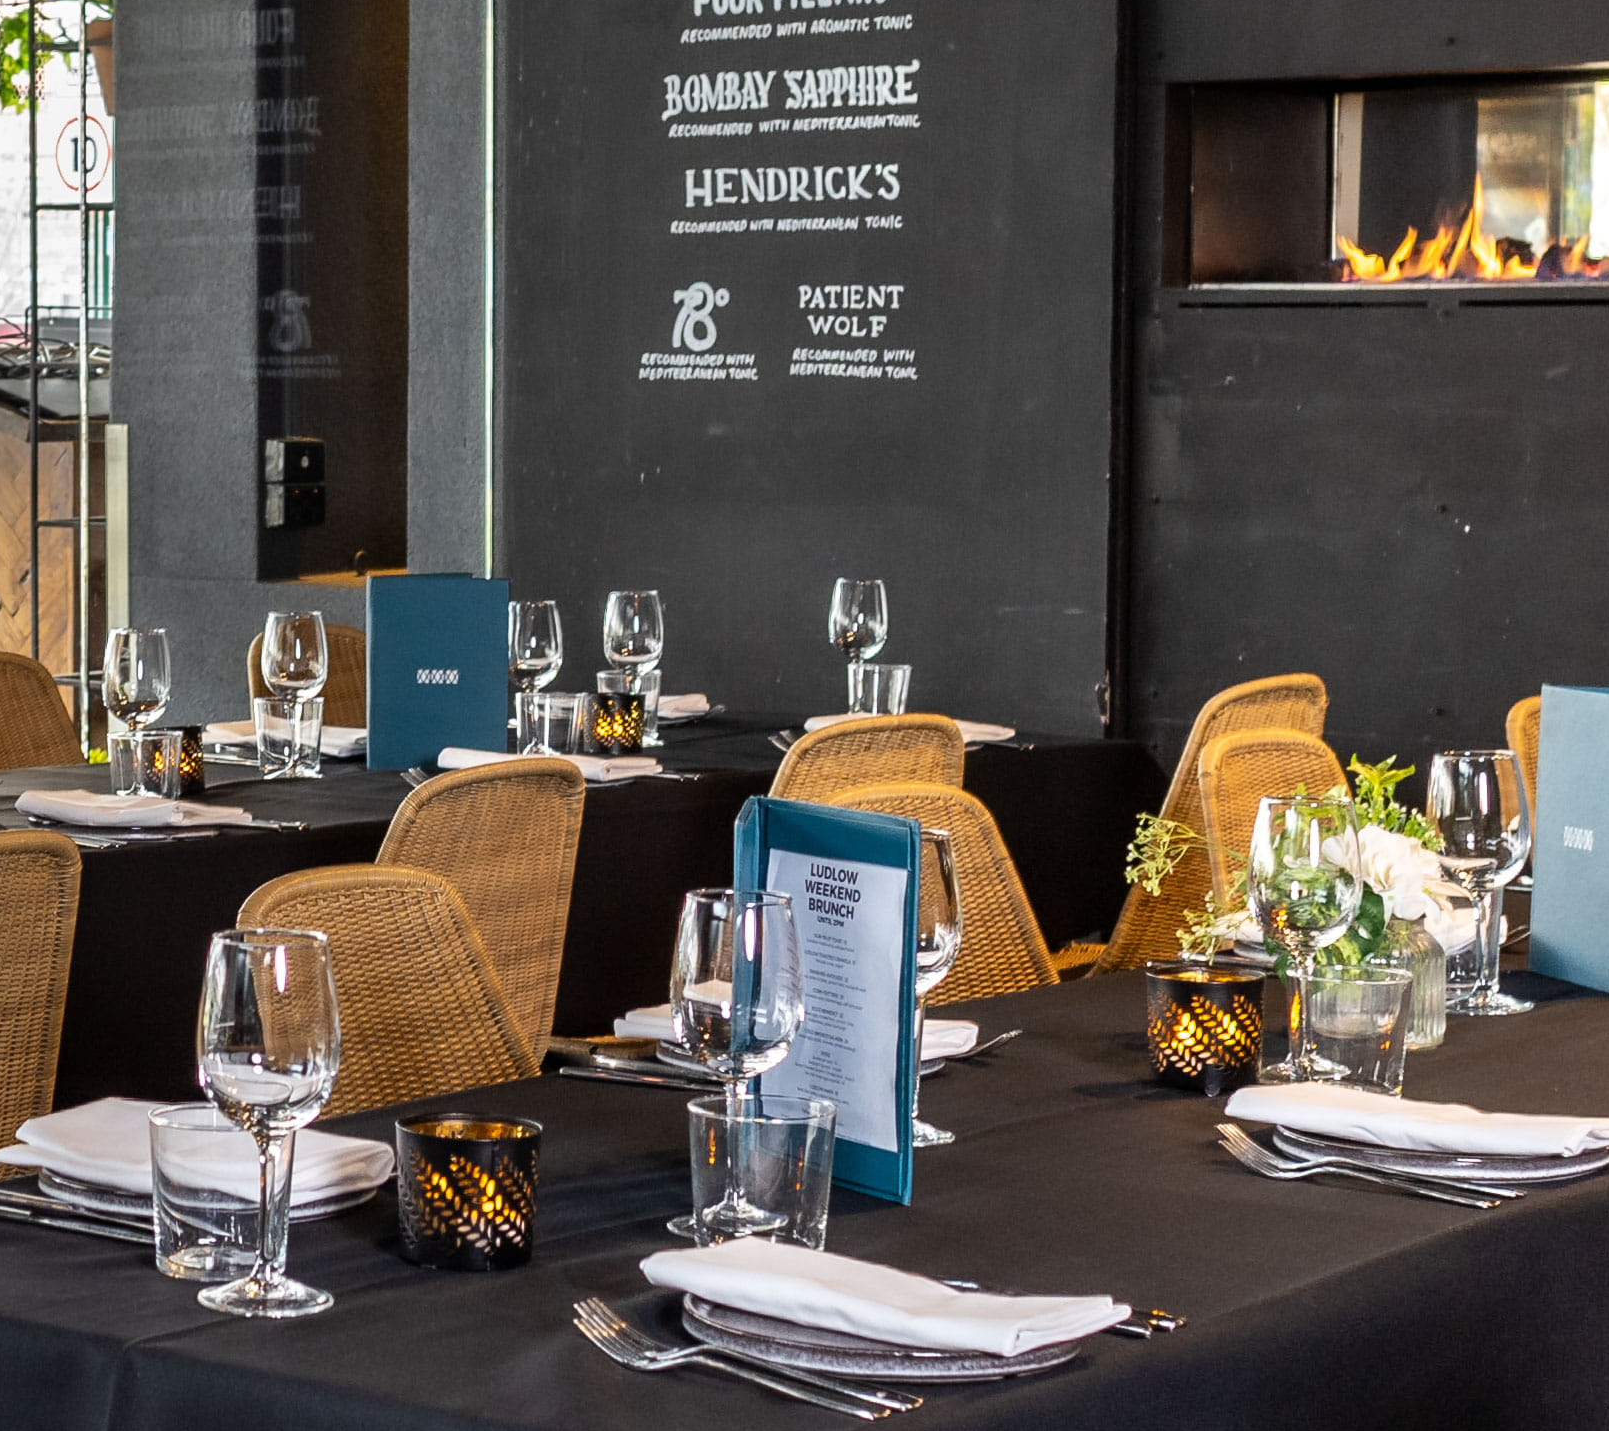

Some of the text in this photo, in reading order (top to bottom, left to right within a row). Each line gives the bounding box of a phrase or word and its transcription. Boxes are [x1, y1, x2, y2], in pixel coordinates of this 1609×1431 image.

[680, 14, 913, 44] RECOMMENDED WITH AROMATIC TONIC
[661, 58, 920, 121] BOMBAY SAPPHIRE
[668, 122, 753, 138] RECOMMENDED
[758, 118, 789, 133] WITH
[887, 114, 921, 128] TONIC
[685, 163, 901, 208] HENDRICK'S
[670, 215, 903, 234] RECOMMENDED WITH MEDITERRANEAN TONIC
[798, 285, 904, 309] PATIENT
[807, 314, 887, 338] WOLF
[641, 352, 755, 367] RECOMMENDED WITH
[792, 348, 915, 362] RECOMMENDED WITH
[638, 367, 759, 381] MEDITERRANEAN TONIC
[789, 363, 918, 379] MEDITERRANEAN TONIC
[810, 863, 859, 885] LUDLOW
[805, 879, 861, 903] WEEKEND
[809, 897, 855, 920] BRUNCH
